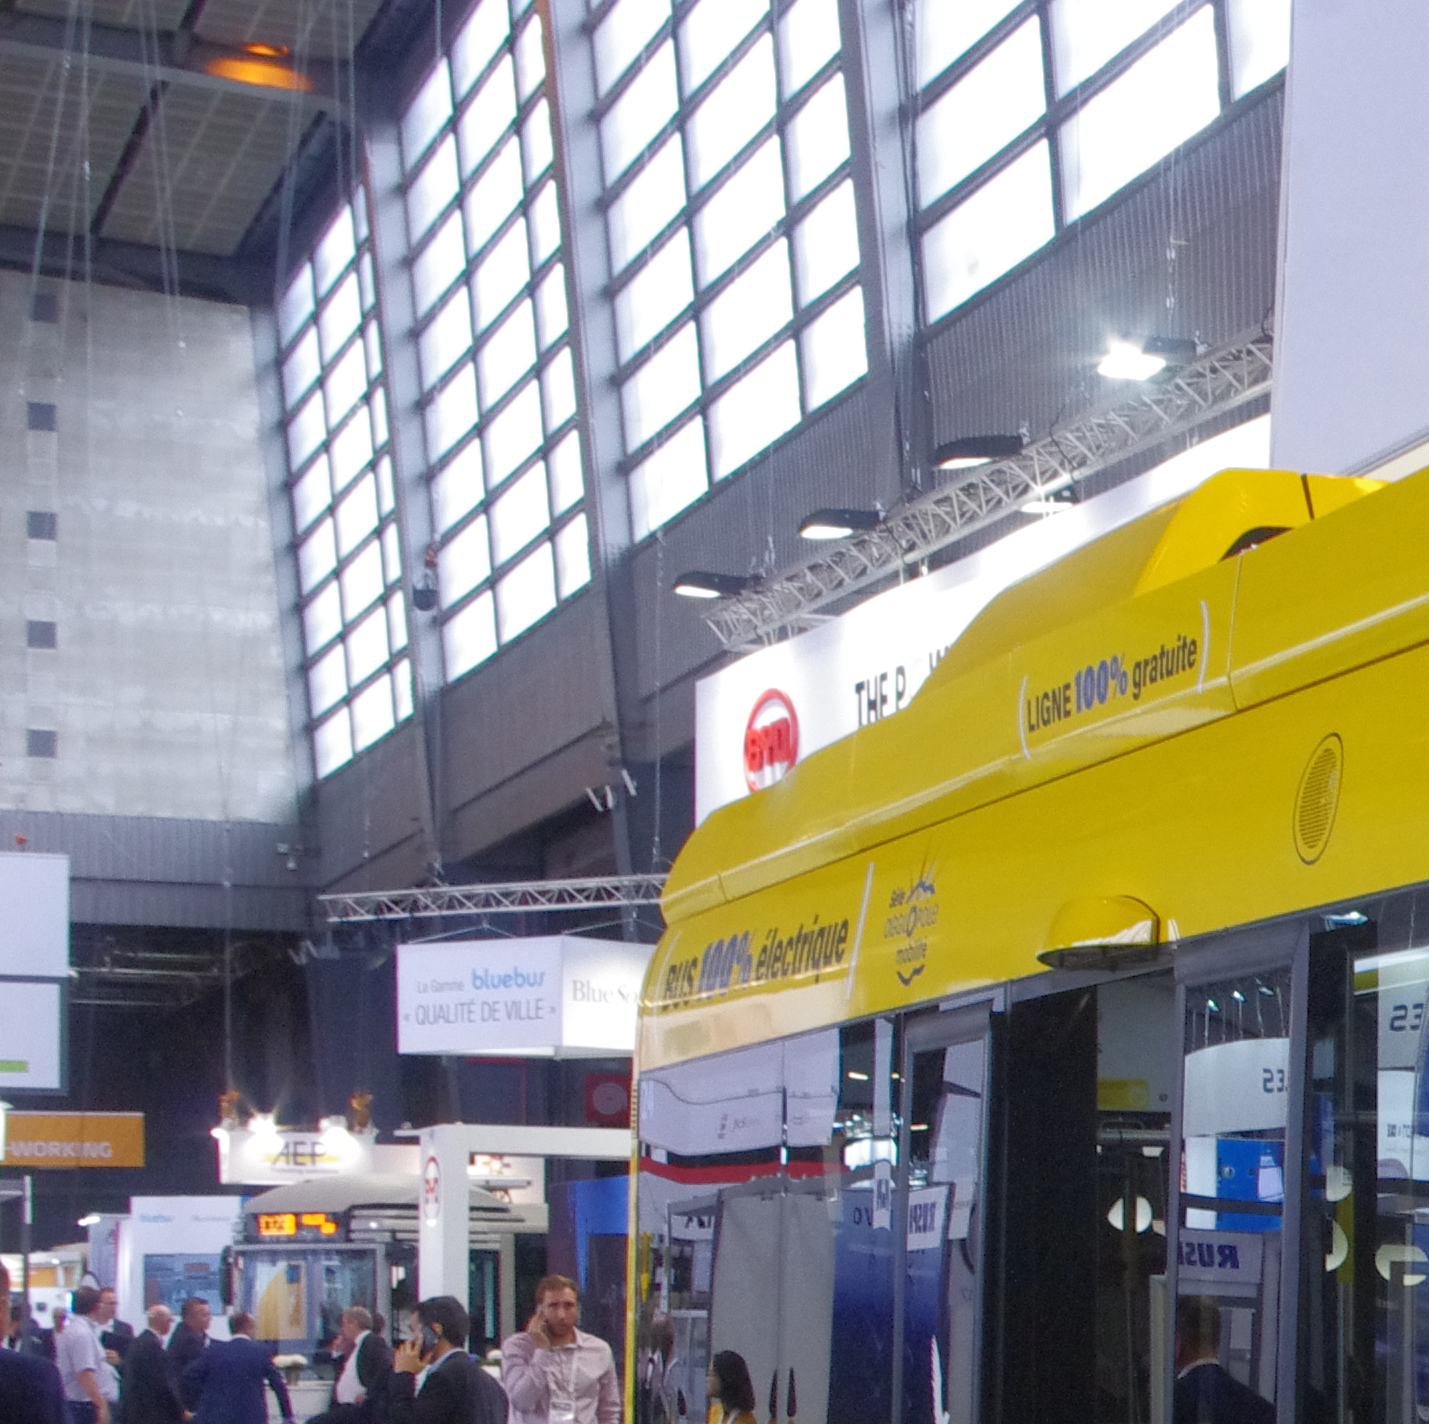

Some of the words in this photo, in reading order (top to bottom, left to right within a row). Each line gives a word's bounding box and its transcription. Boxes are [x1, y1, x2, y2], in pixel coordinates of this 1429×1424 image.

[1027, 682, 1072, 732] LIGNE
[1074, 652, 1129, 714] 100%
[1132, 634, 1198, 701] gratuite
[571, 978, 613, 1003] Blue
[616, 983, 643, 1006] So
[661, 955, 699, 1011] BUS
[696, 928, 756, 1002] 100%
[756, 914, 849, 985] électrique
[415, 999, 476, 1026] QUALITÉ
[481, 1001, 500, 1022] DE
[506, 998, 545, 1022] VILLE
